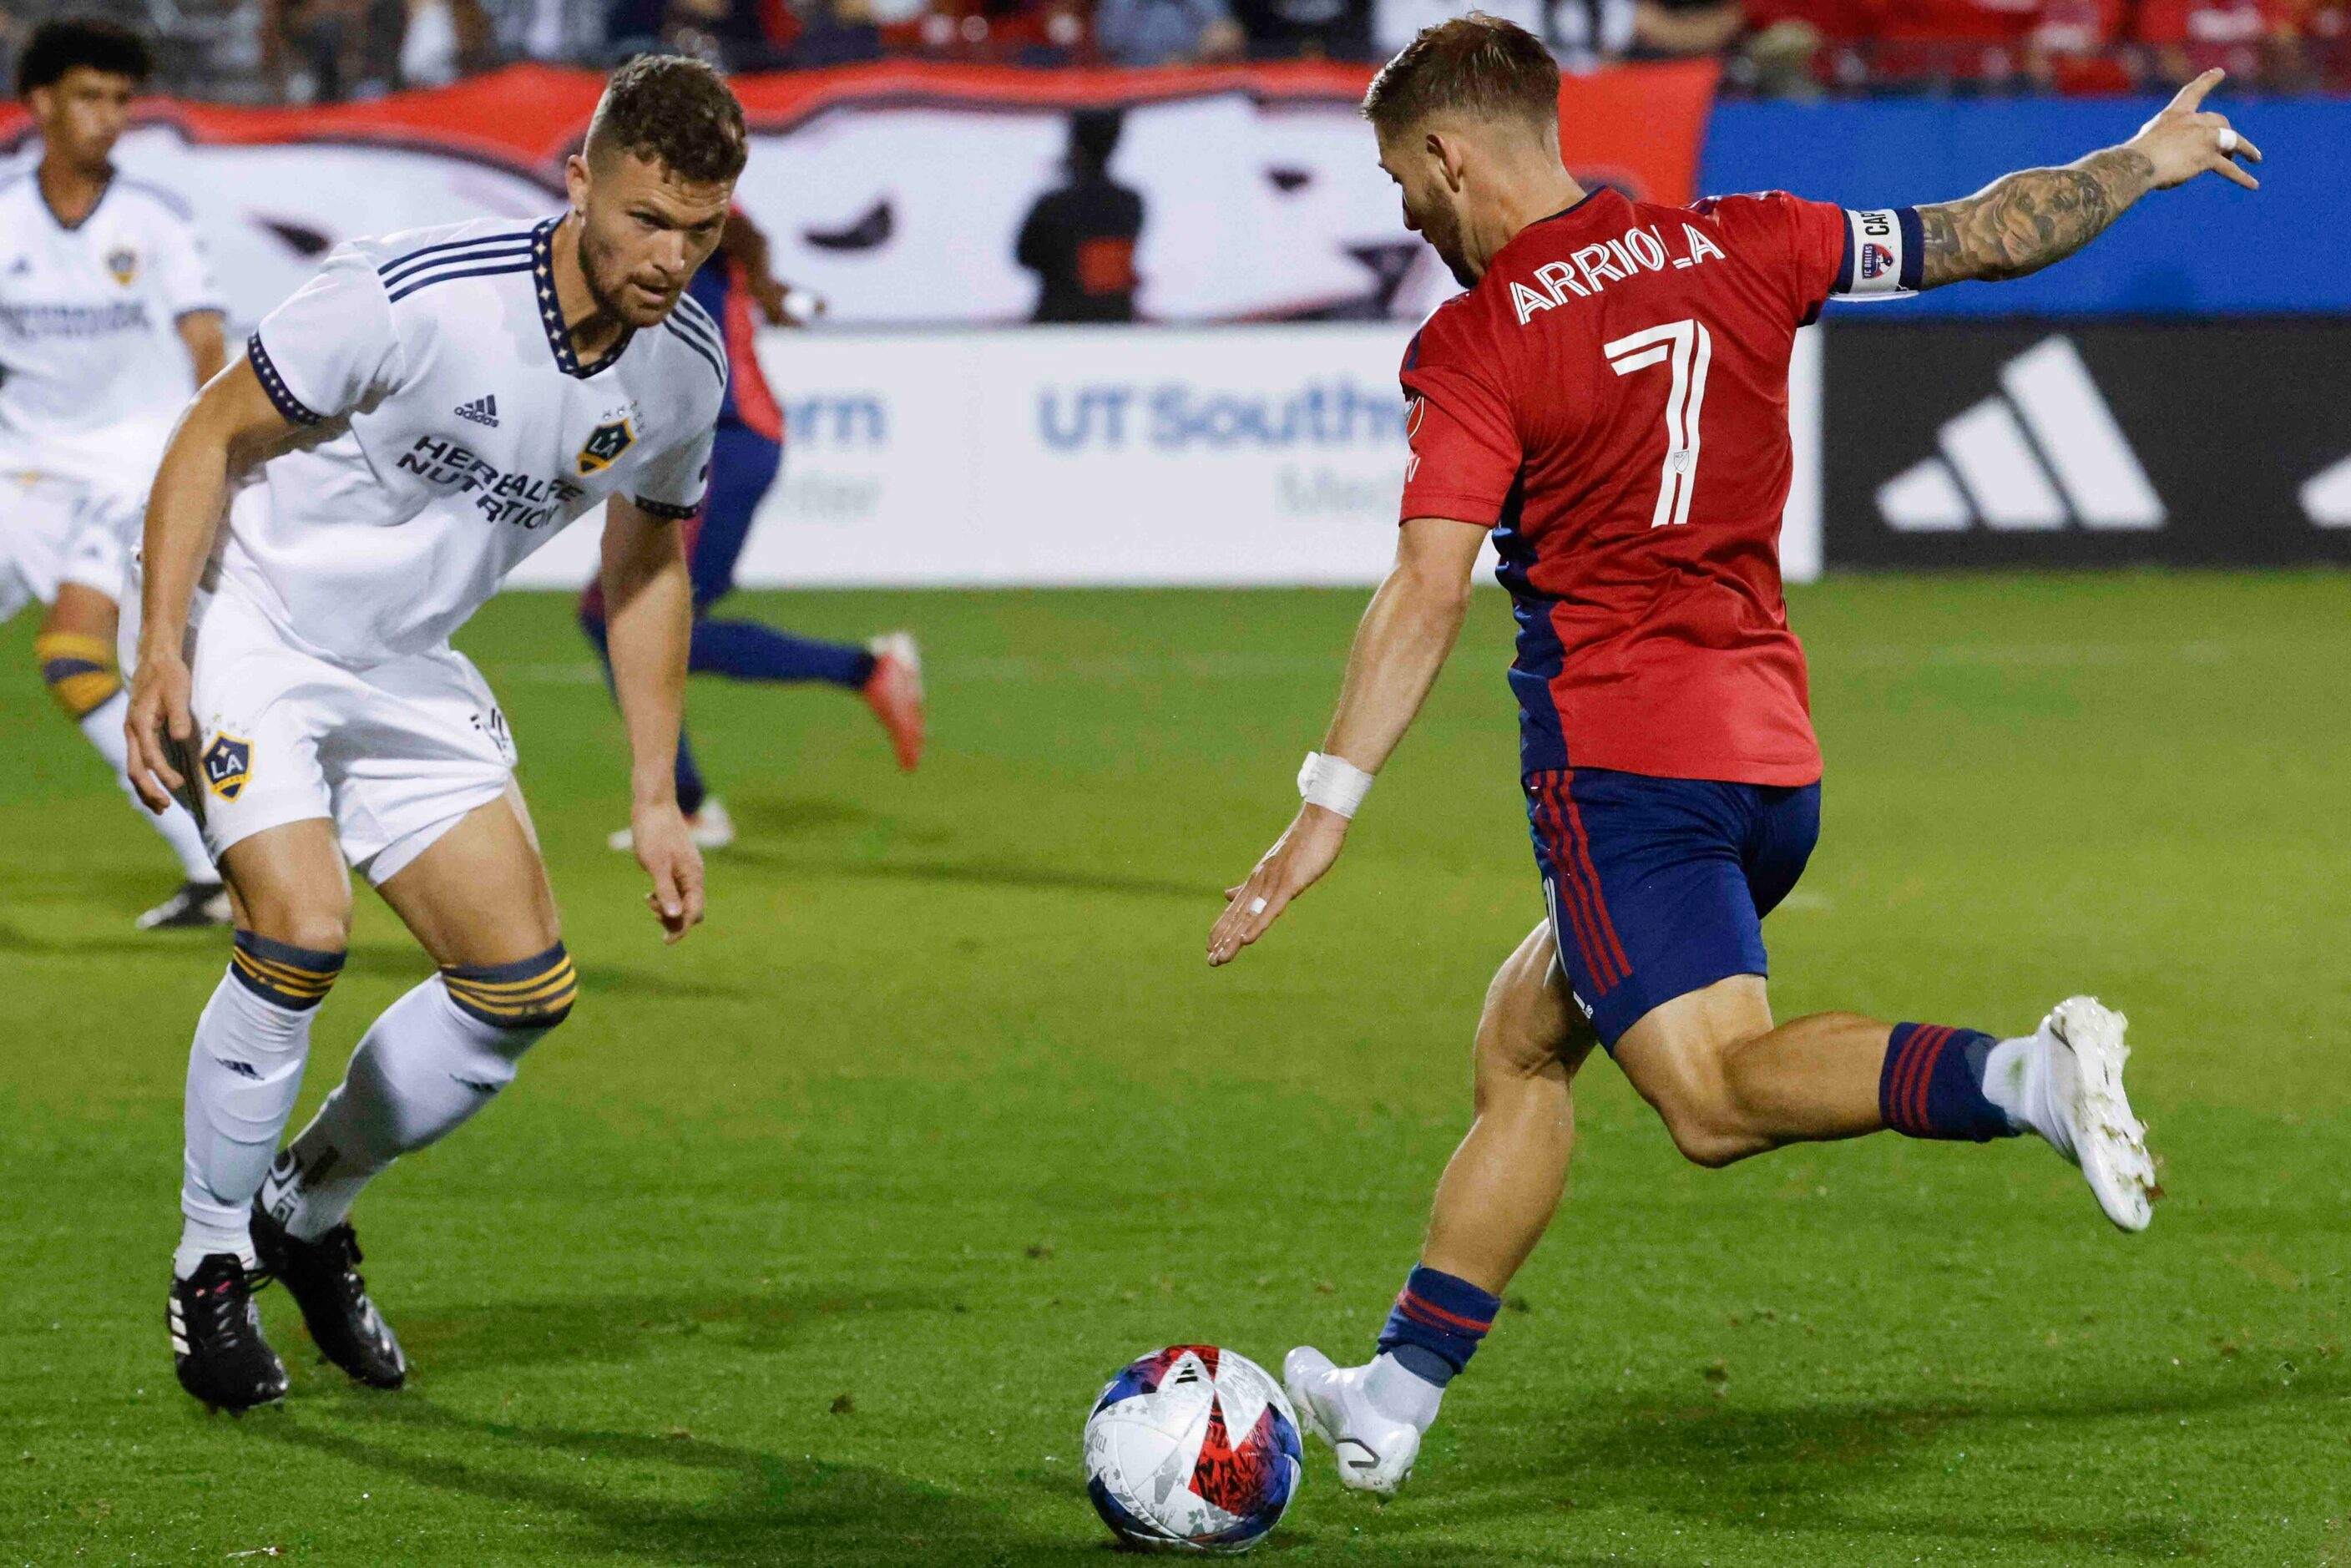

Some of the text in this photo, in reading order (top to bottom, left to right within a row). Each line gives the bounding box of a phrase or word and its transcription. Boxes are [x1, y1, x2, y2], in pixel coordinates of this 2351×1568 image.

[1509, 222, 1726, 326] ARRIOLA
[1864, 245, 1873, 267] DALLAS
[454, 407, 499, 427] adidas
[589, 436, 616, 455] LA
[1039, 387, 1130, 450] UT
[1604, 319, 1711, 528] 7
[396, 453, 560, 530] NUTRTION
[413, 435, 584, 502] HERBALFE
[210, 754, 244, 779] LA
